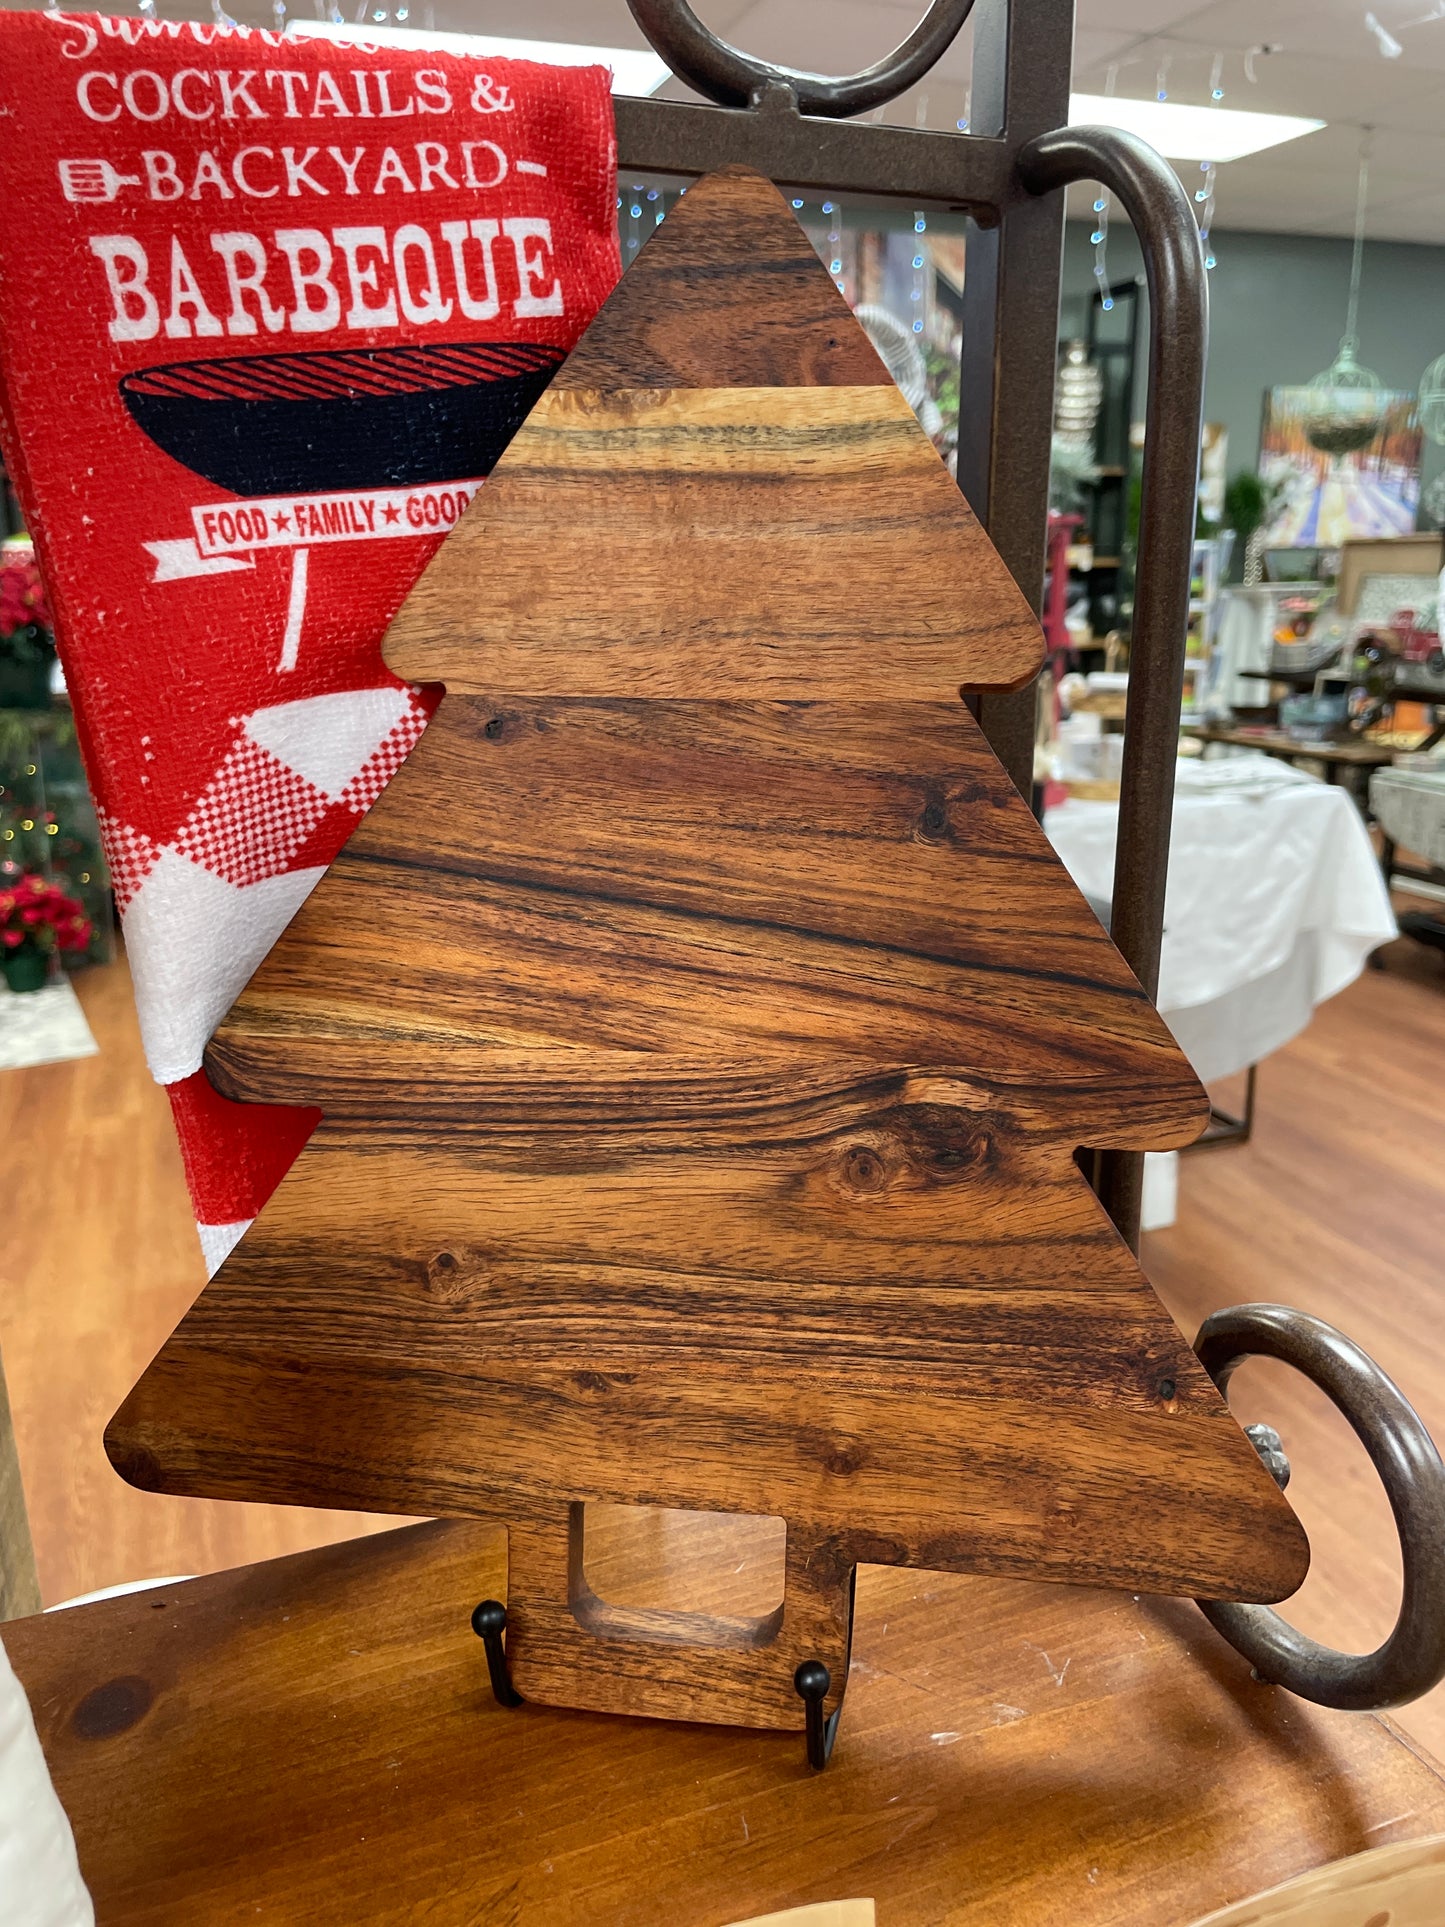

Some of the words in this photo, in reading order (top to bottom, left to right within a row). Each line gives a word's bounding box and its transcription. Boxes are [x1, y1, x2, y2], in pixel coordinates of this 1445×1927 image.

[76, 68, 453, 121] COCKTAILS
[470, 73, 514, 114] &
[143, 140, 508, 201] BACKYARD
[89, 217, 564, 342] BARBEQUE
[202, 508, 269, 546] FOOD
[294, 499, 375, 537] FAMILY
